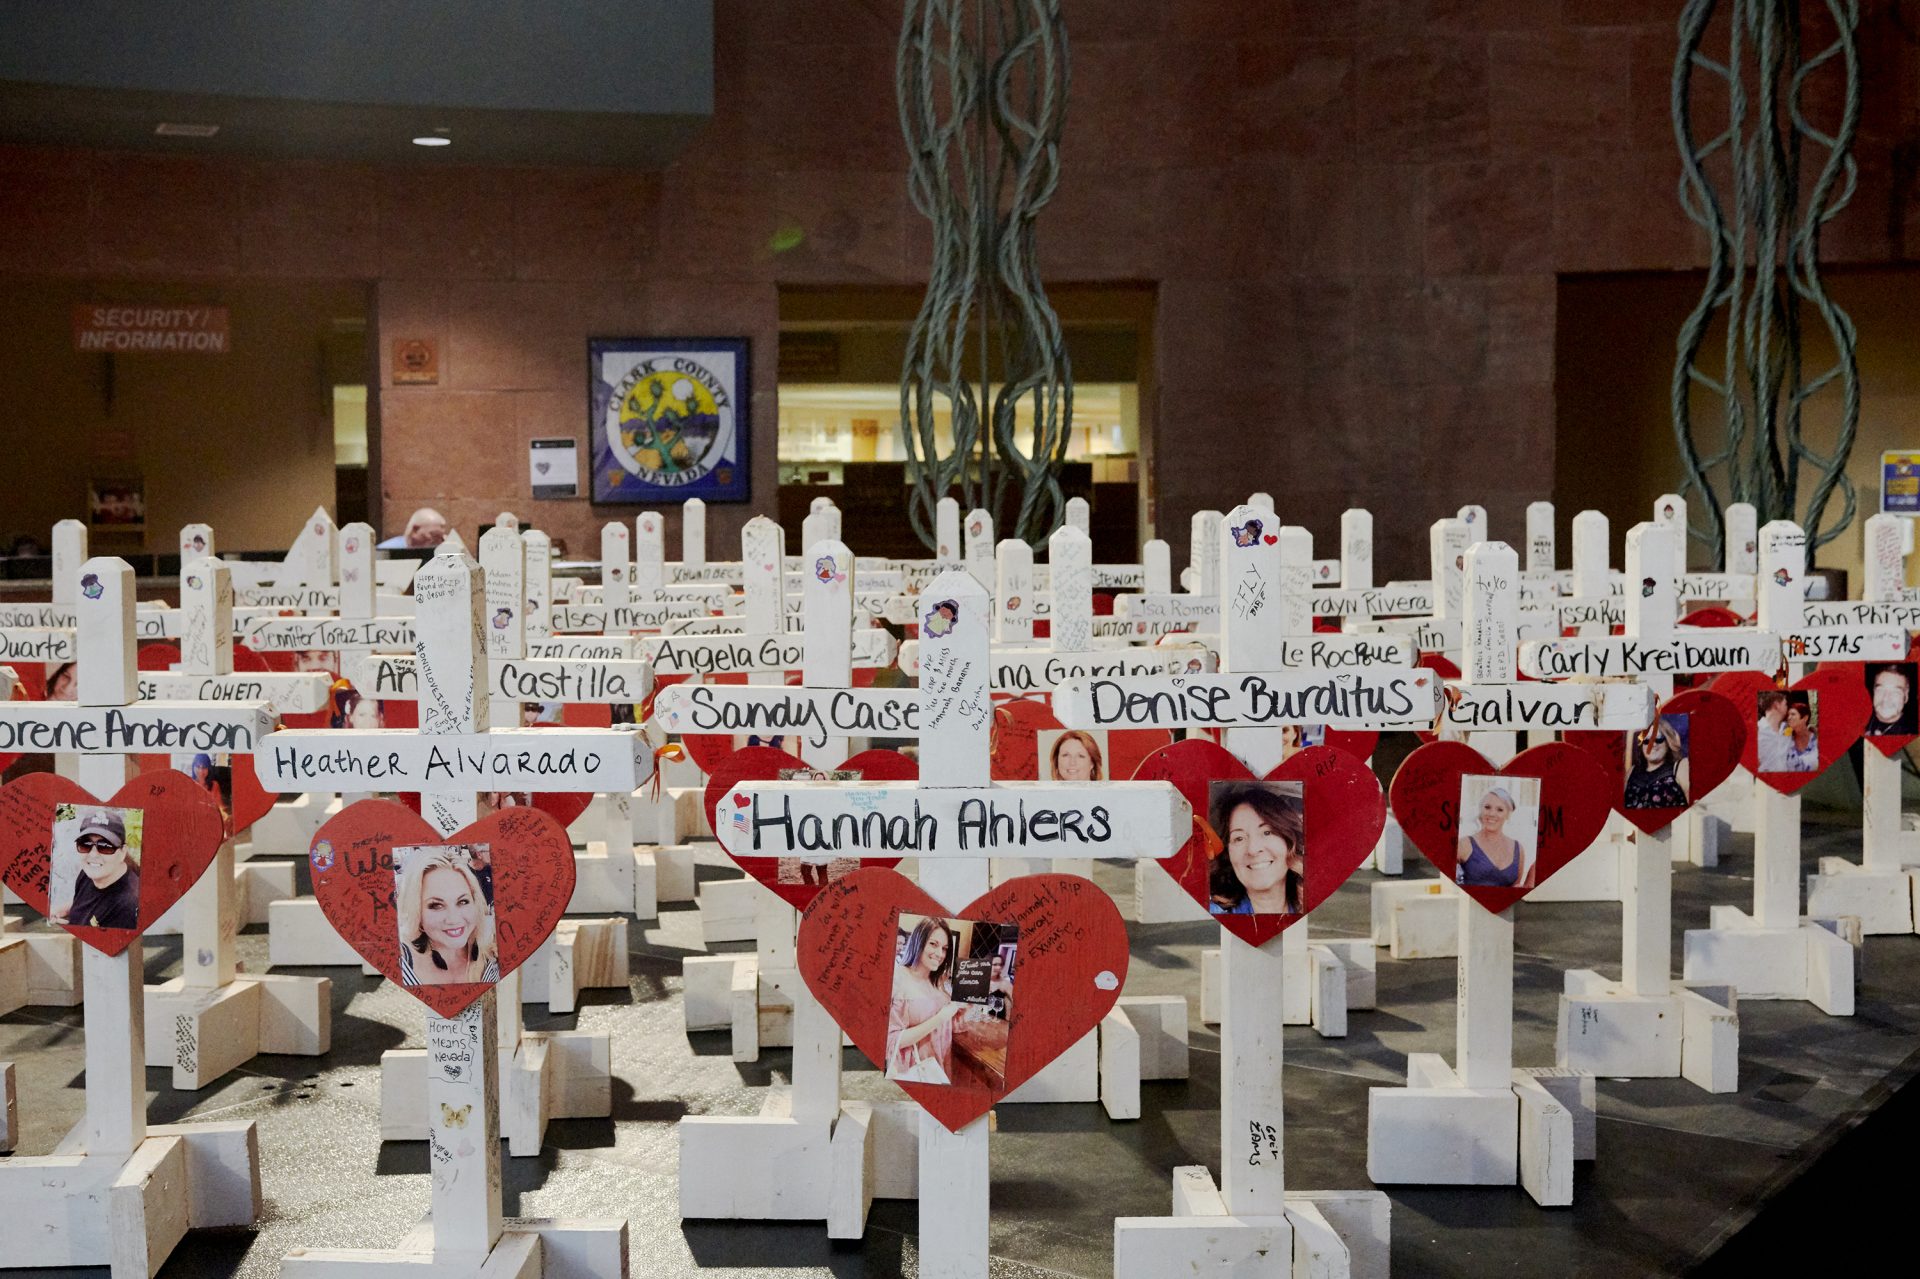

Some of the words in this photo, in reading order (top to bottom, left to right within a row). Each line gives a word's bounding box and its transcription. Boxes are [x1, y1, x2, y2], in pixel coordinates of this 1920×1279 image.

[92, 308, 199, 327] SECURITY
[79, 331, 225, 349] INFORMATION
[609, 360, 657, 411] CLARK
[673, 357, 731, 409] COUNTY
[636, 463, 710, 485] NEVADA
[652, 639, 754, 674] Angela
[1538, 644, 1610, 676] Carly
[1621, 641, 1750, 671] Kreibaum
[500, 662, 631, 701] Castilla
[950, 661, 971, 694] Banana
[1091, 676, 1238, 724] Denise
[1240, 675, 1414, 724] Burditus
[105, 708, 252, 750] Anderson
[690, 687, 828, 748] Sandy
[1314, 753, 1337, 777] RIP
[752, 791, 938, 851] Hannah
[1058, 880, 1082, 896] RIP
[429, 1020, 458, 1035] Home
[432, 1037, 467, 1051] Means
[434, 1050, 471, 1064] Nevada
